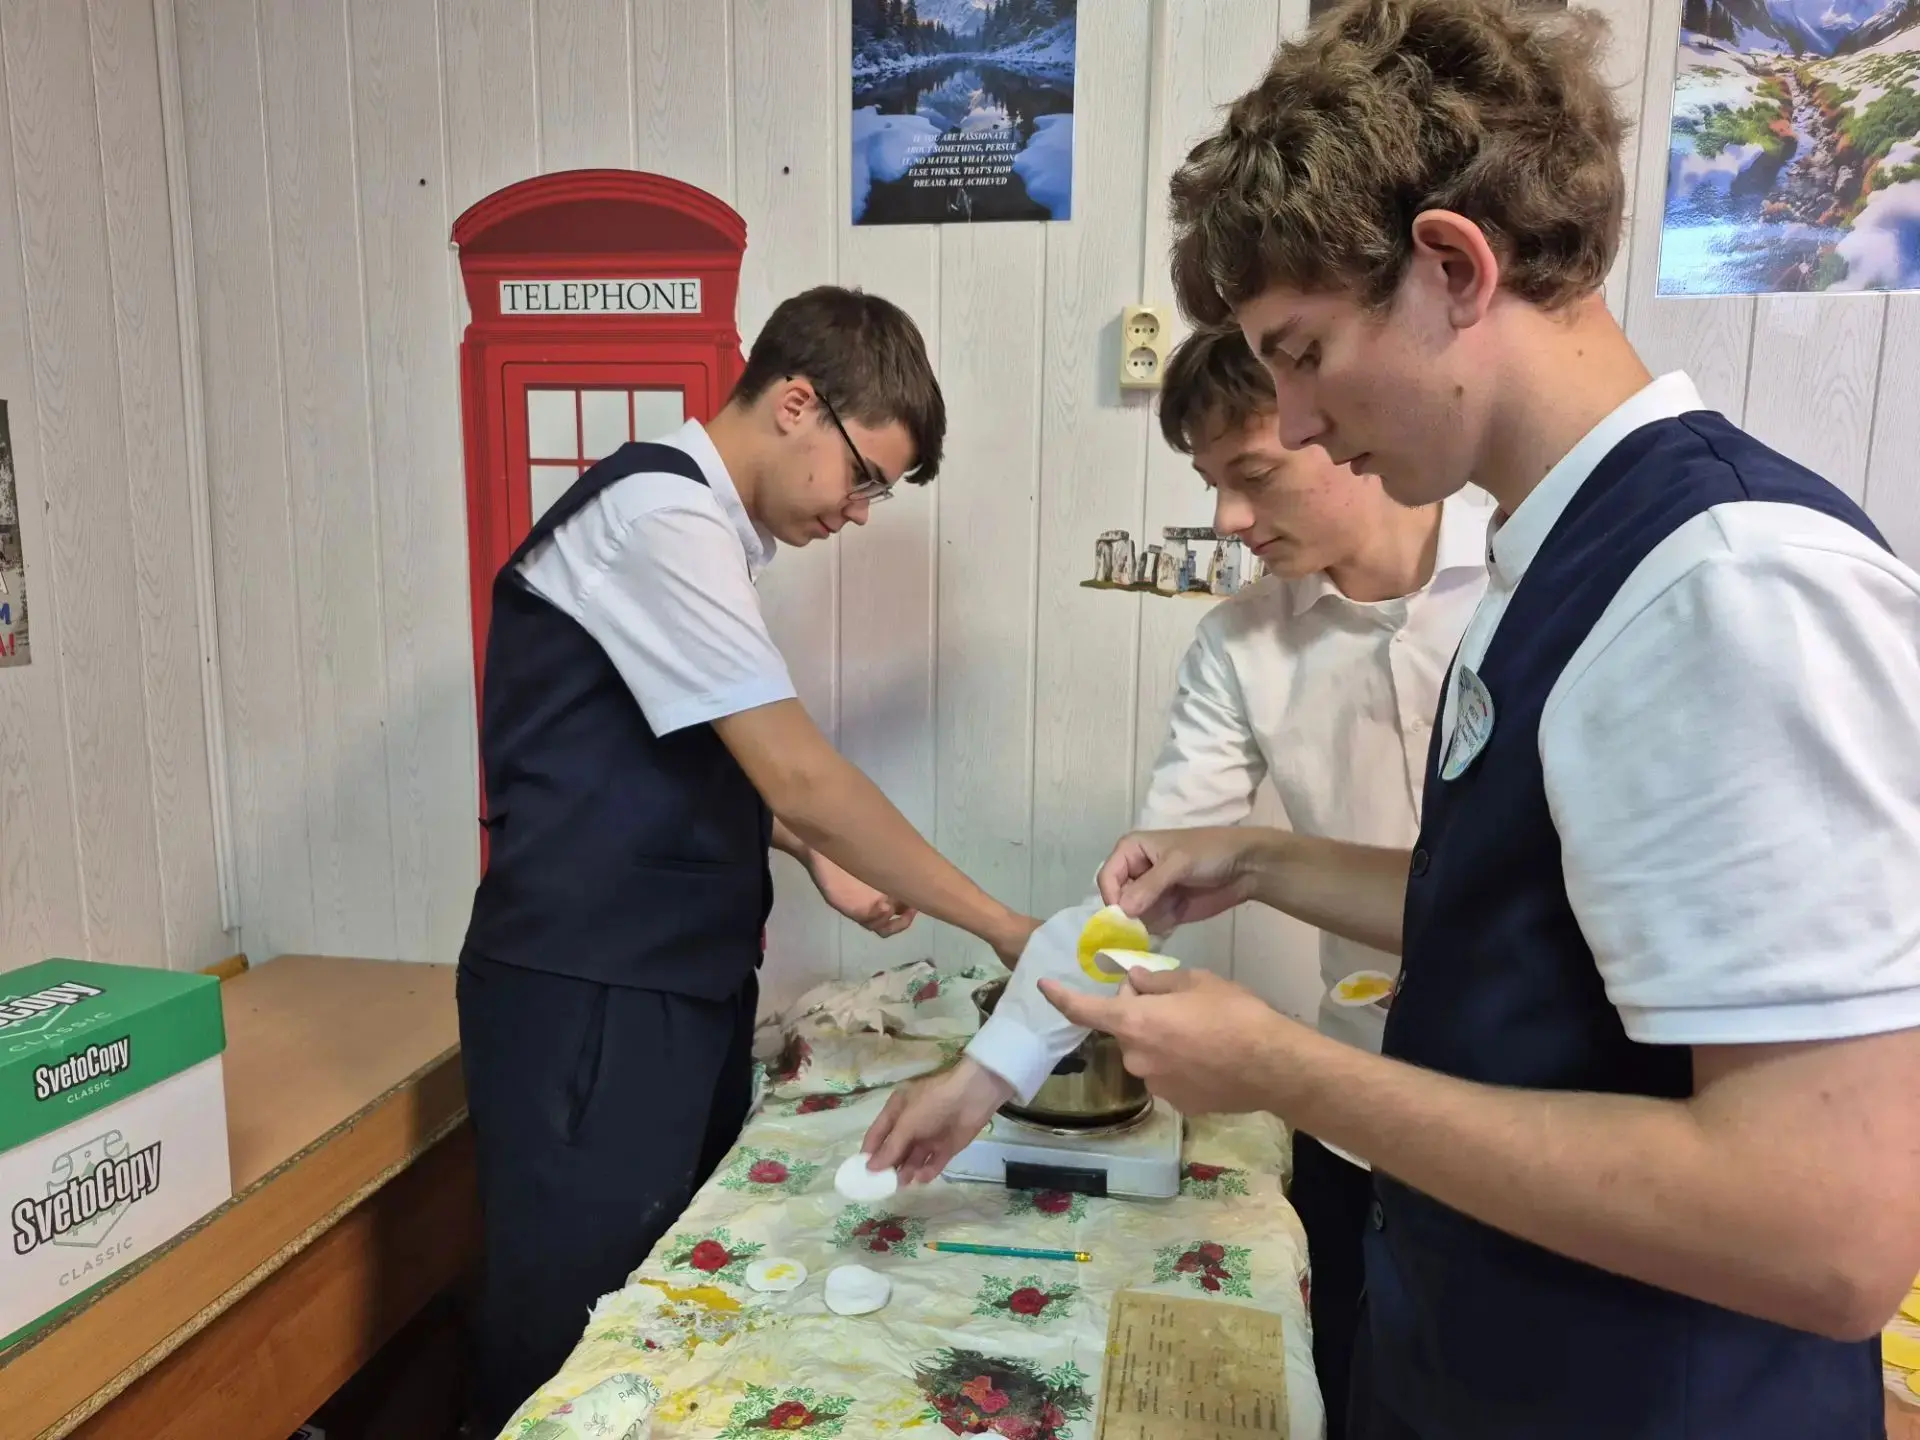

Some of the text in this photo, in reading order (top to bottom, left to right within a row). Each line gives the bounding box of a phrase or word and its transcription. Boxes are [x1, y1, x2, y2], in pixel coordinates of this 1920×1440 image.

[932, 144, 984, 153] SOMETHING,
[985, 142, 1018, 151] PERSUE
[941, 133, 958, 141] ARE
[959, 131, 1009, 141] PASSIONATE
[908, 168, 929, 176] ELSE
[963, 166, 992, 175] THAT'S
[993, 165, 1012, 174] HOW
[914, 156, 926, 164] NO
[926, 155, 960, 165] MATTER
[961, 154, 985, 163] WHAT
[986, 153, 1018, 162] ANYON
[913, 176, 1008, 188] DREAMS ARE ACHIEVED
[503, 282, 698, 311] TELEPHONE
[8, 1012, 112, 1052] CLASSIC
[33, 1035, 131, 1102] SvetoCopy
[66, 1079, 112, 1104] CLASSIC
[11, 1140, 162, 1255] SvetoCopy
[58, 1236, 134, 1287] CLASSIC
